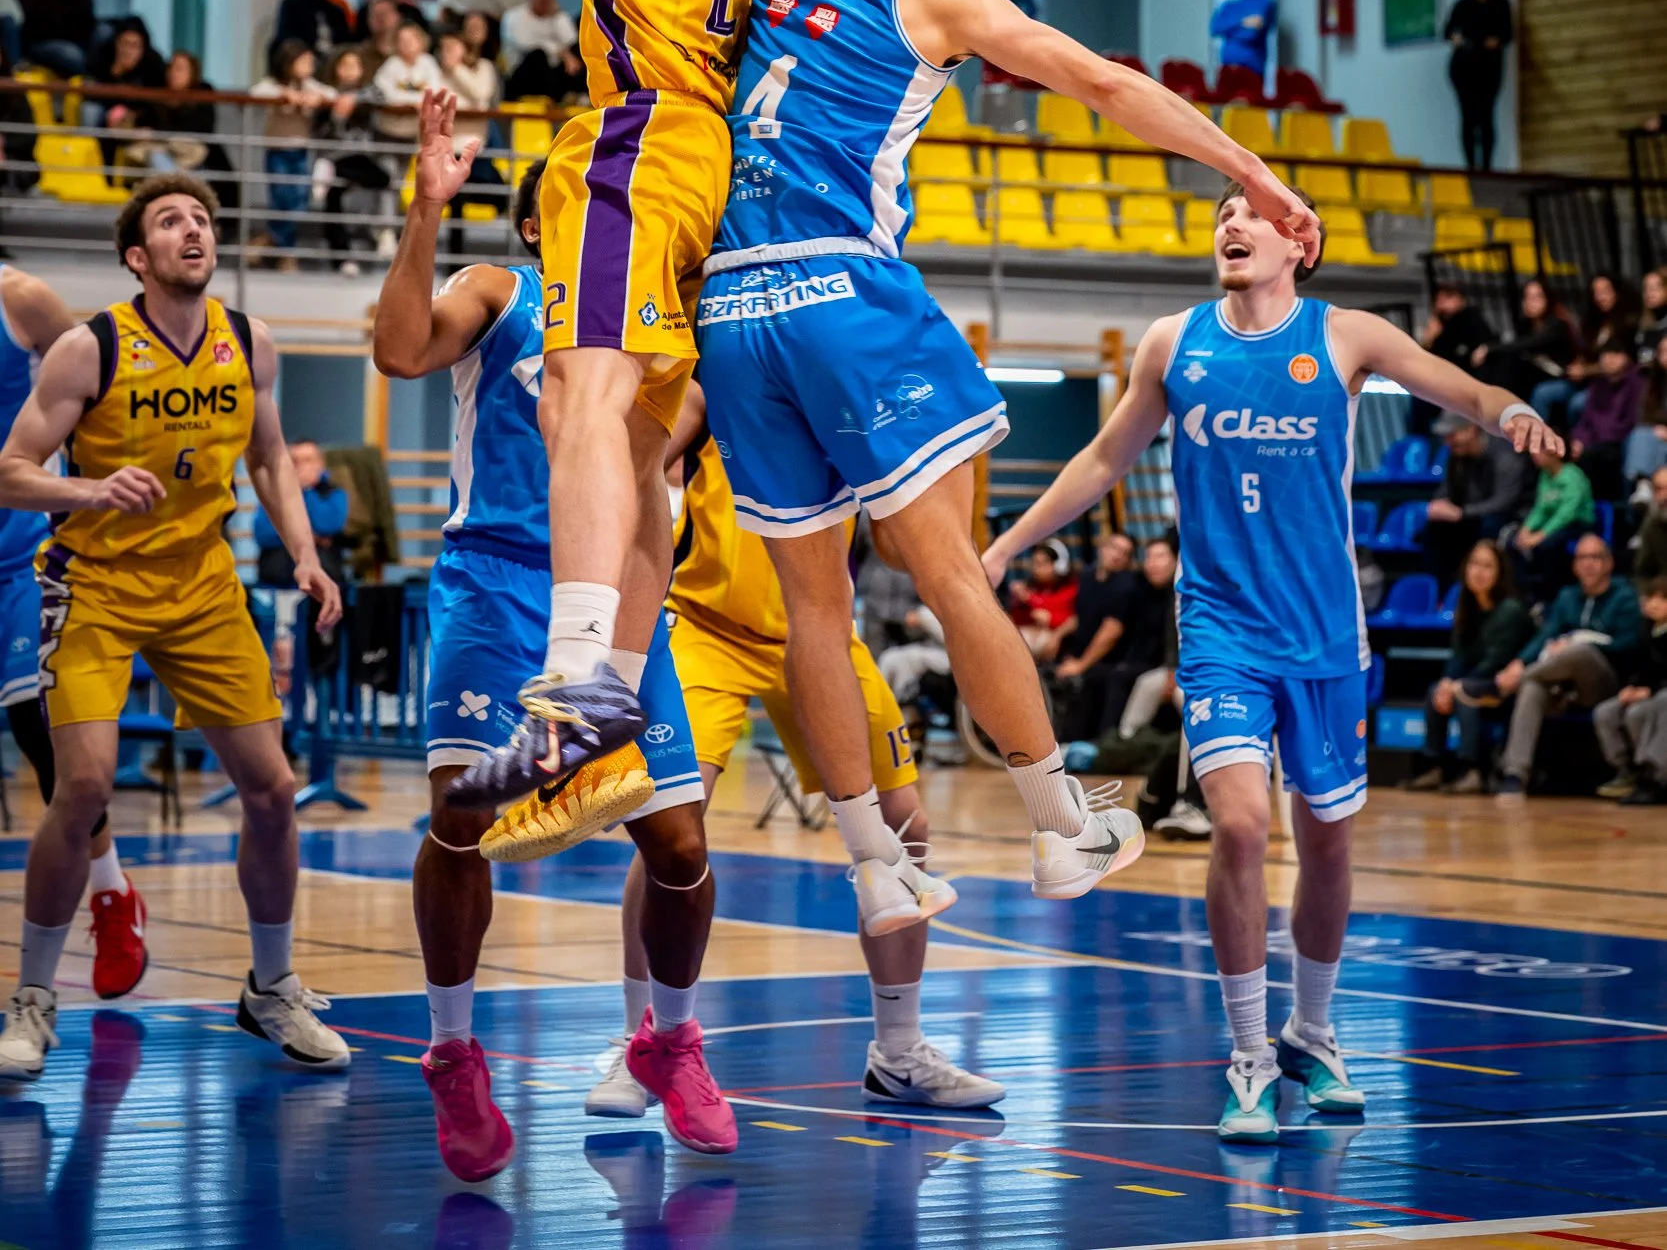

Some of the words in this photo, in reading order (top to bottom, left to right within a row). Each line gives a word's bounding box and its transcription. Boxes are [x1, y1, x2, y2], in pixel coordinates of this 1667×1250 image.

[735, 186, 772, 201] IBIZA
[545, 282, 567, 330] 2
[130, 385, 237, 419] HOMS
[164, 420, 211, 433] RENTALS
[1212, 408, 1319, 440] Class
[173, 448, 196, 480] 6
[1256, 445, 1286, 456] Rent
[1289, 446, 1298, 456] a
[1241, 473, 1261, 514] 5
